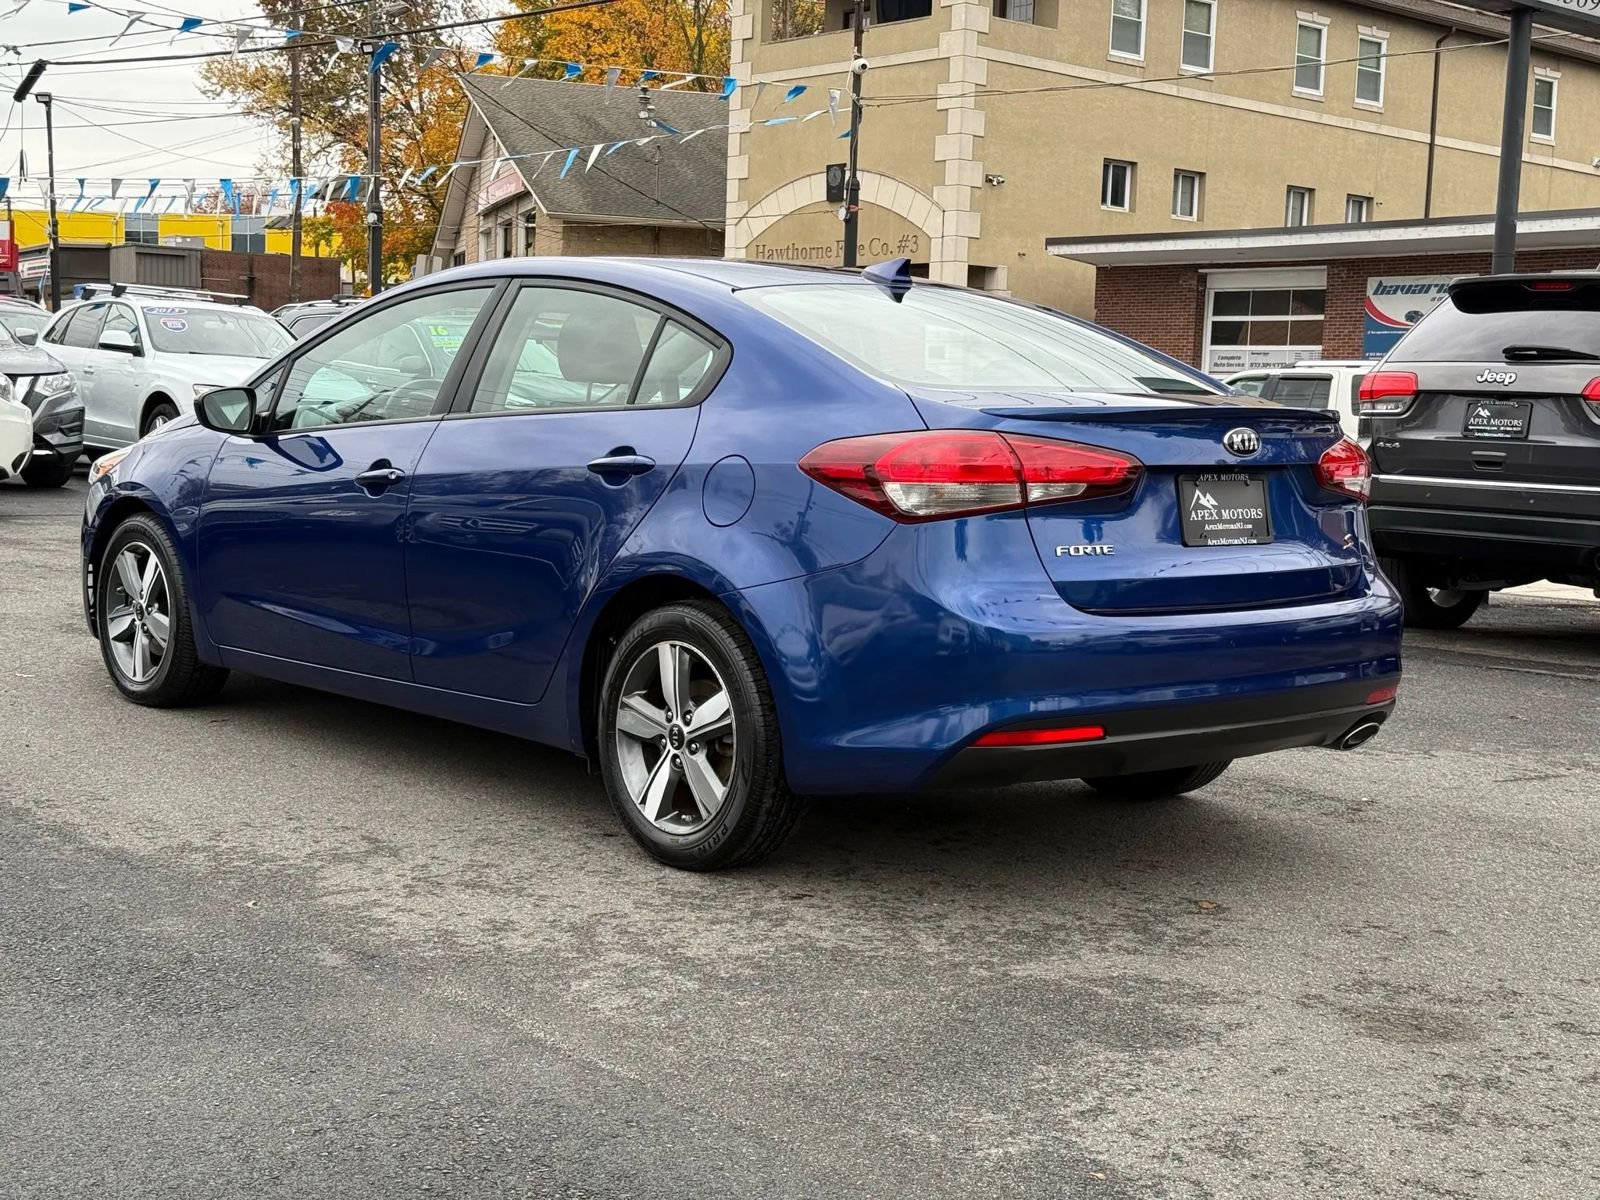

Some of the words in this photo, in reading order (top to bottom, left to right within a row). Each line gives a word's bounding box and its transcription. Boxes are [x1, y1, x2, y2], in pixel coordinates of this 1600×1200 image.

[755, 243, 832, 260] Hawthorne
[835, 240, 865, 258] Fe
[869, 238, 893, 257] Co.
[896, 234, 919, 255] #3
[1217, 354, 1242, 362] Complete
[1476, 368, 1517, 386] Jeep
[1231, 433, 1258, 451] KIA
[1199, 473, 1218, 481] APEX
[1220, 473, 1249, 481] MOTORS
[1190, 509, 1219, 521] APEX
[1221, 508, 1263, 520] MOTORS
[1055, 544, 1116, 558] FORTE
